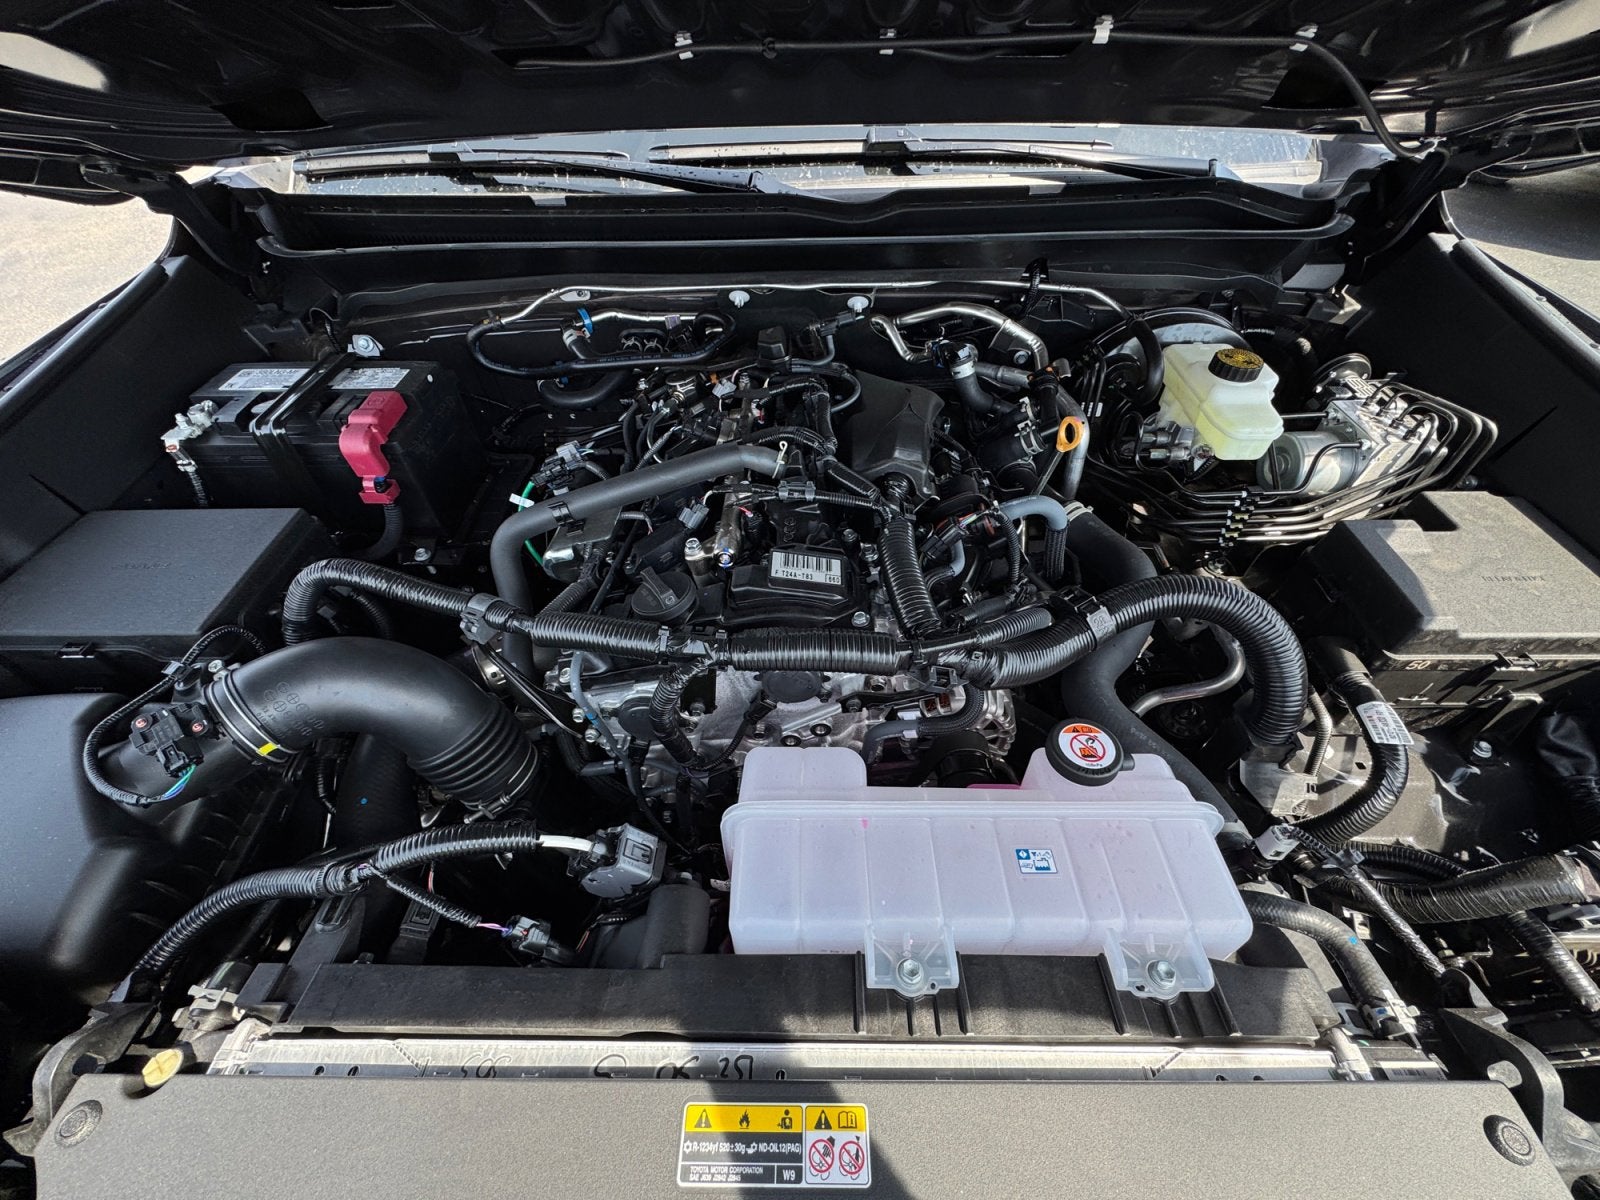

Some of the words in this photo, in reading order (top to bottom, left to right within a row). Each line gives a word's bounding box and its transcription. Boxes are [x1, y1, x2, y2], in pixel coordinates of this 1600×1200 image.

[1405, 660, 1431, 670] 50
[692, 1142, 718, 1155] R-1234yf
[689, 1166, 709, 1174] TOYOTA
[710, 1166, 729, 1174] MOTOR
[729, 1166, 764, 1175] CORPORATION
[783, 1169, 796, 1181] W9
